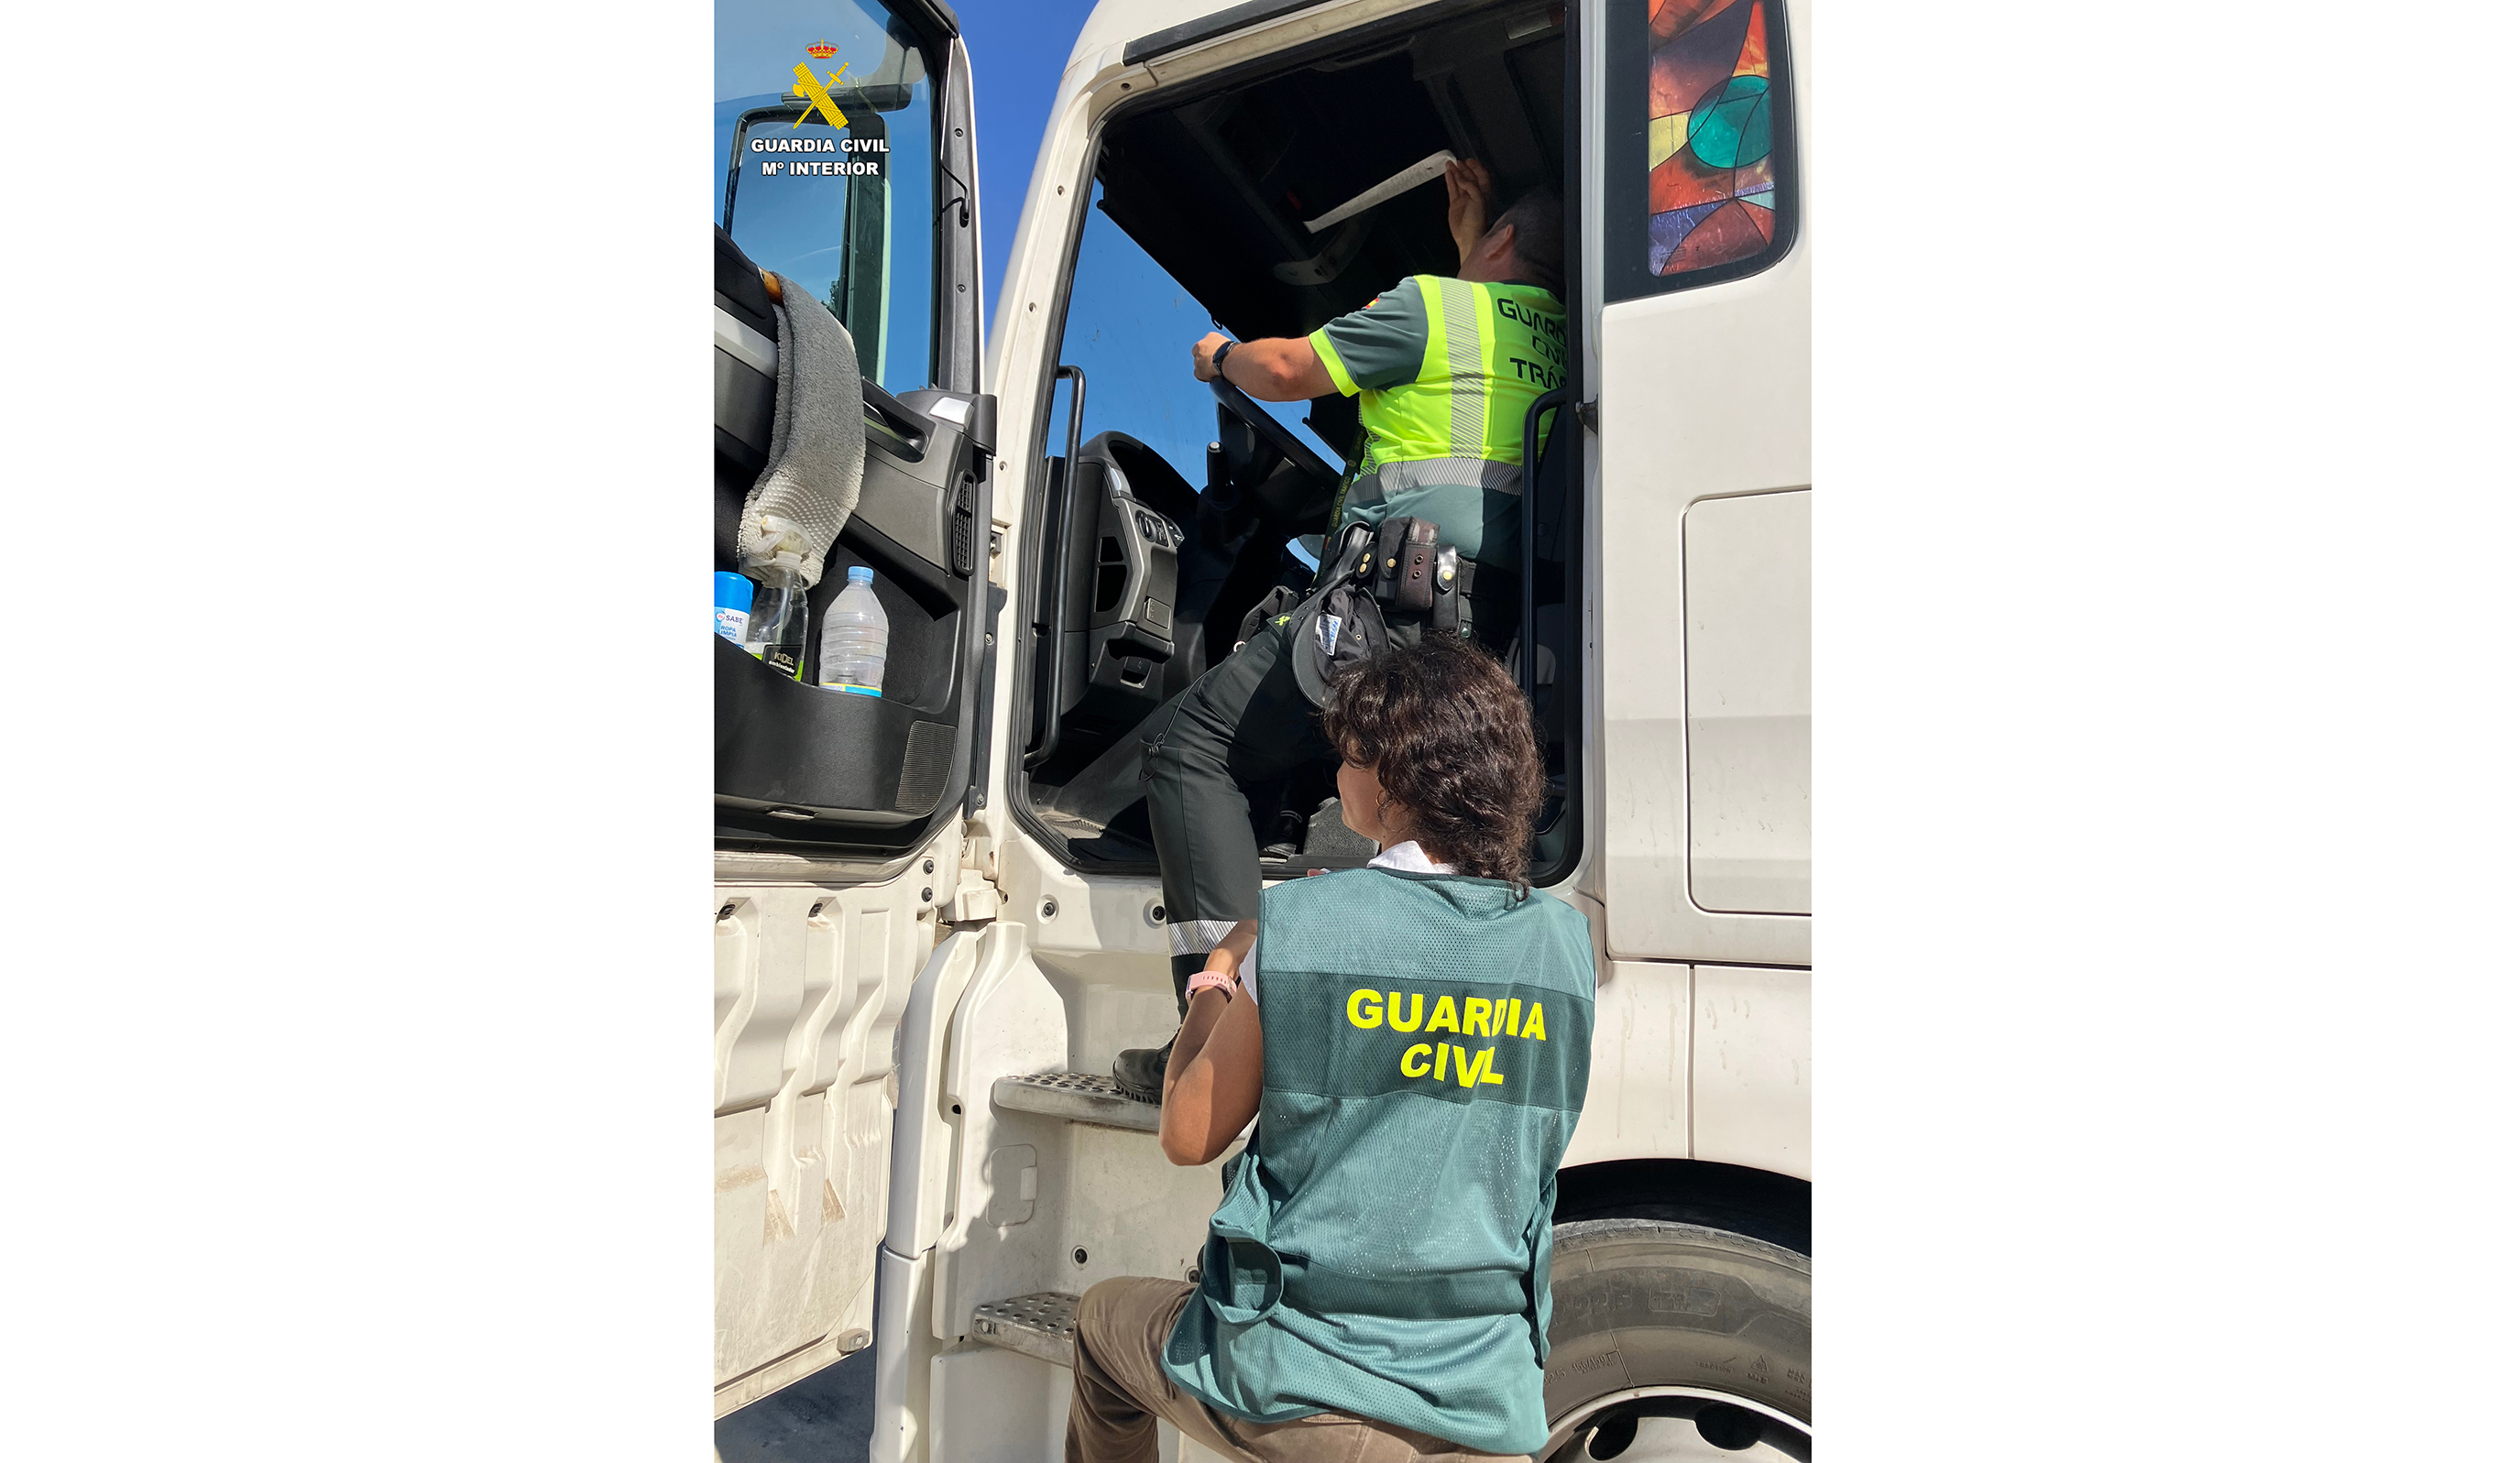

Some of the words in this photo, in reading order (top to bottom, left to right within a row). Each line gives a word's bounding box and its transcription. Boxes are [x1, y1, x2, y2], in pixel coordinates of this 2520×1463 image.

[1496, 298, 1567, 348] GUARD
[1331, 508, 1341, 528] GUARDIA
[1337, 496, 1345, 506] CIVIL
[718, 629, 737, 638] LIMPIA
[726, 615, 743, 624] SABE
[774, 651, 794, 666] KIDEL
[1346, 988, 1547, 1042] GUARDIA
[1400, 1042, 1504, 1088] CIVL
